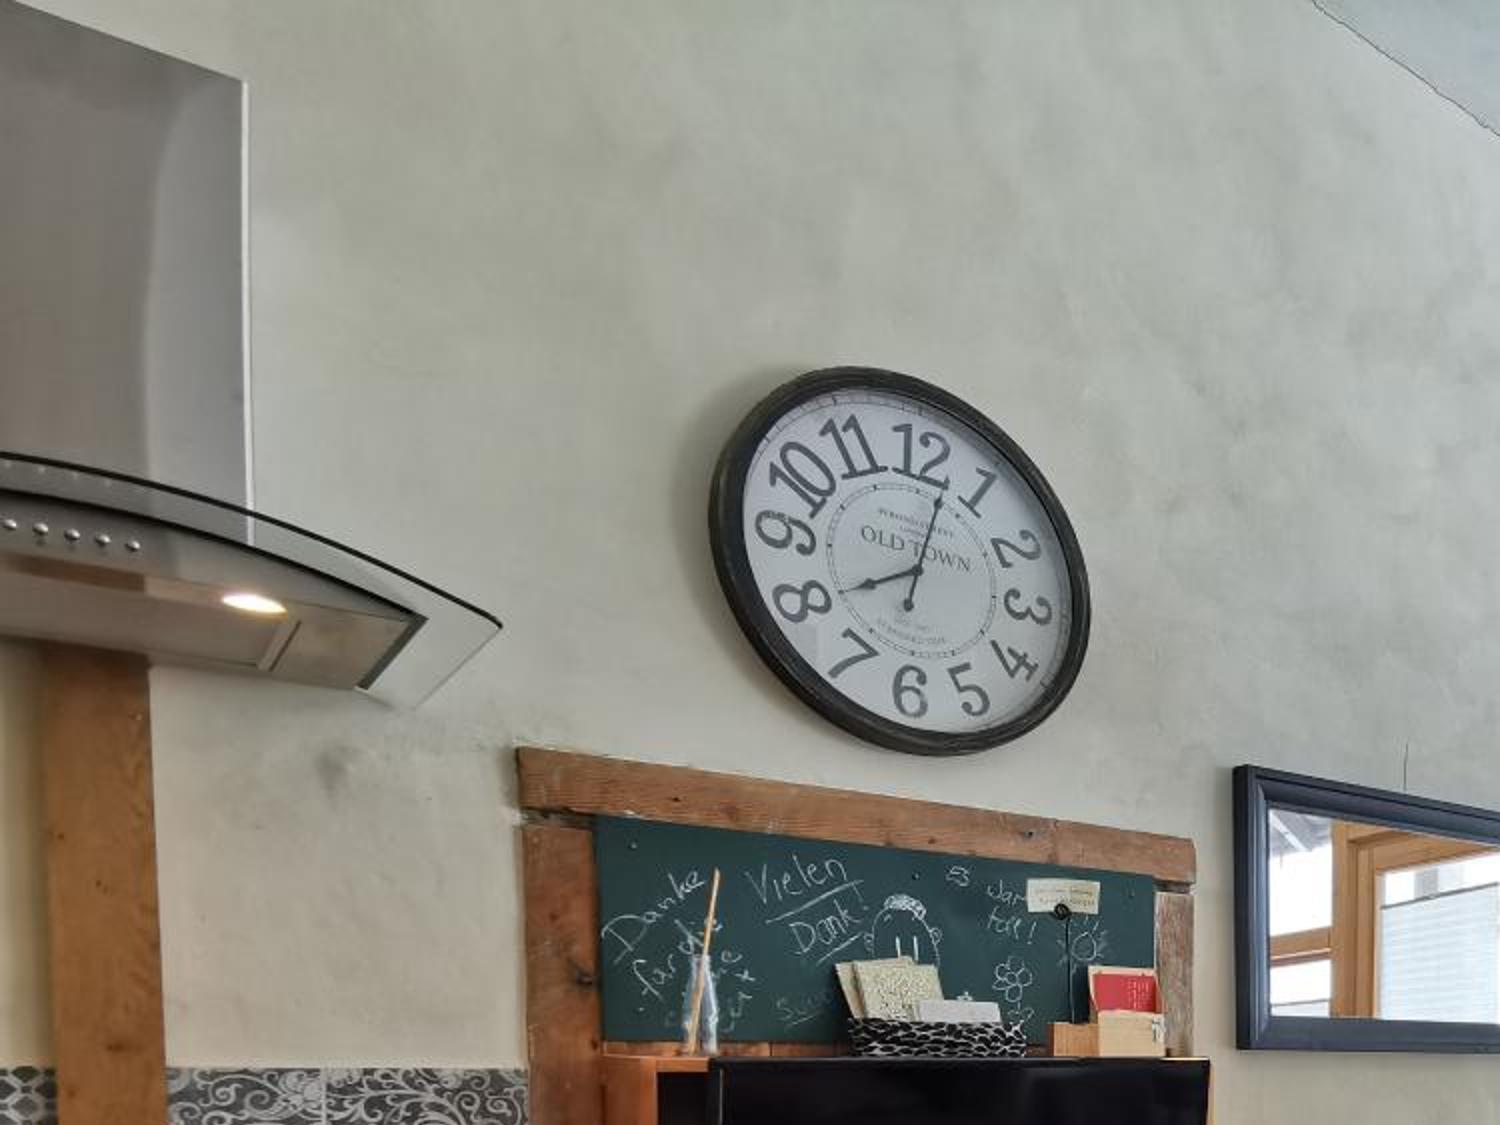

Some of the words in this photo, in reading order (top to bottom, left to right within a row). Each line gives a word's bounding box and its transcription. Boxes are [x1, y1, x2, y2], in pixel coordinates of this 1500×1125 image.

[819, 414, 888, 480] 11
[892, 423, 949, 490] 12
[769, 441, 837, 519] 10
[957, 467, 997, 518] 1
[755, 509, 817, 556] 9
[861, 525, 904, 551] OLD
[908, 540, 971, 571] TOWN
[990, 529, 1041, 568] 2
[772, 580, 832, 623] 8
[1004, 588, 1052, 625] 3
[828, 628, 880, 679] 7
[991, 640, 1039, 681] 4
[892, 664, 928, 718] 6
[947, 662, 990, 716] 5
[744, 855, 848, 904] Vielen
[601, 871, 704, 965] Danke
